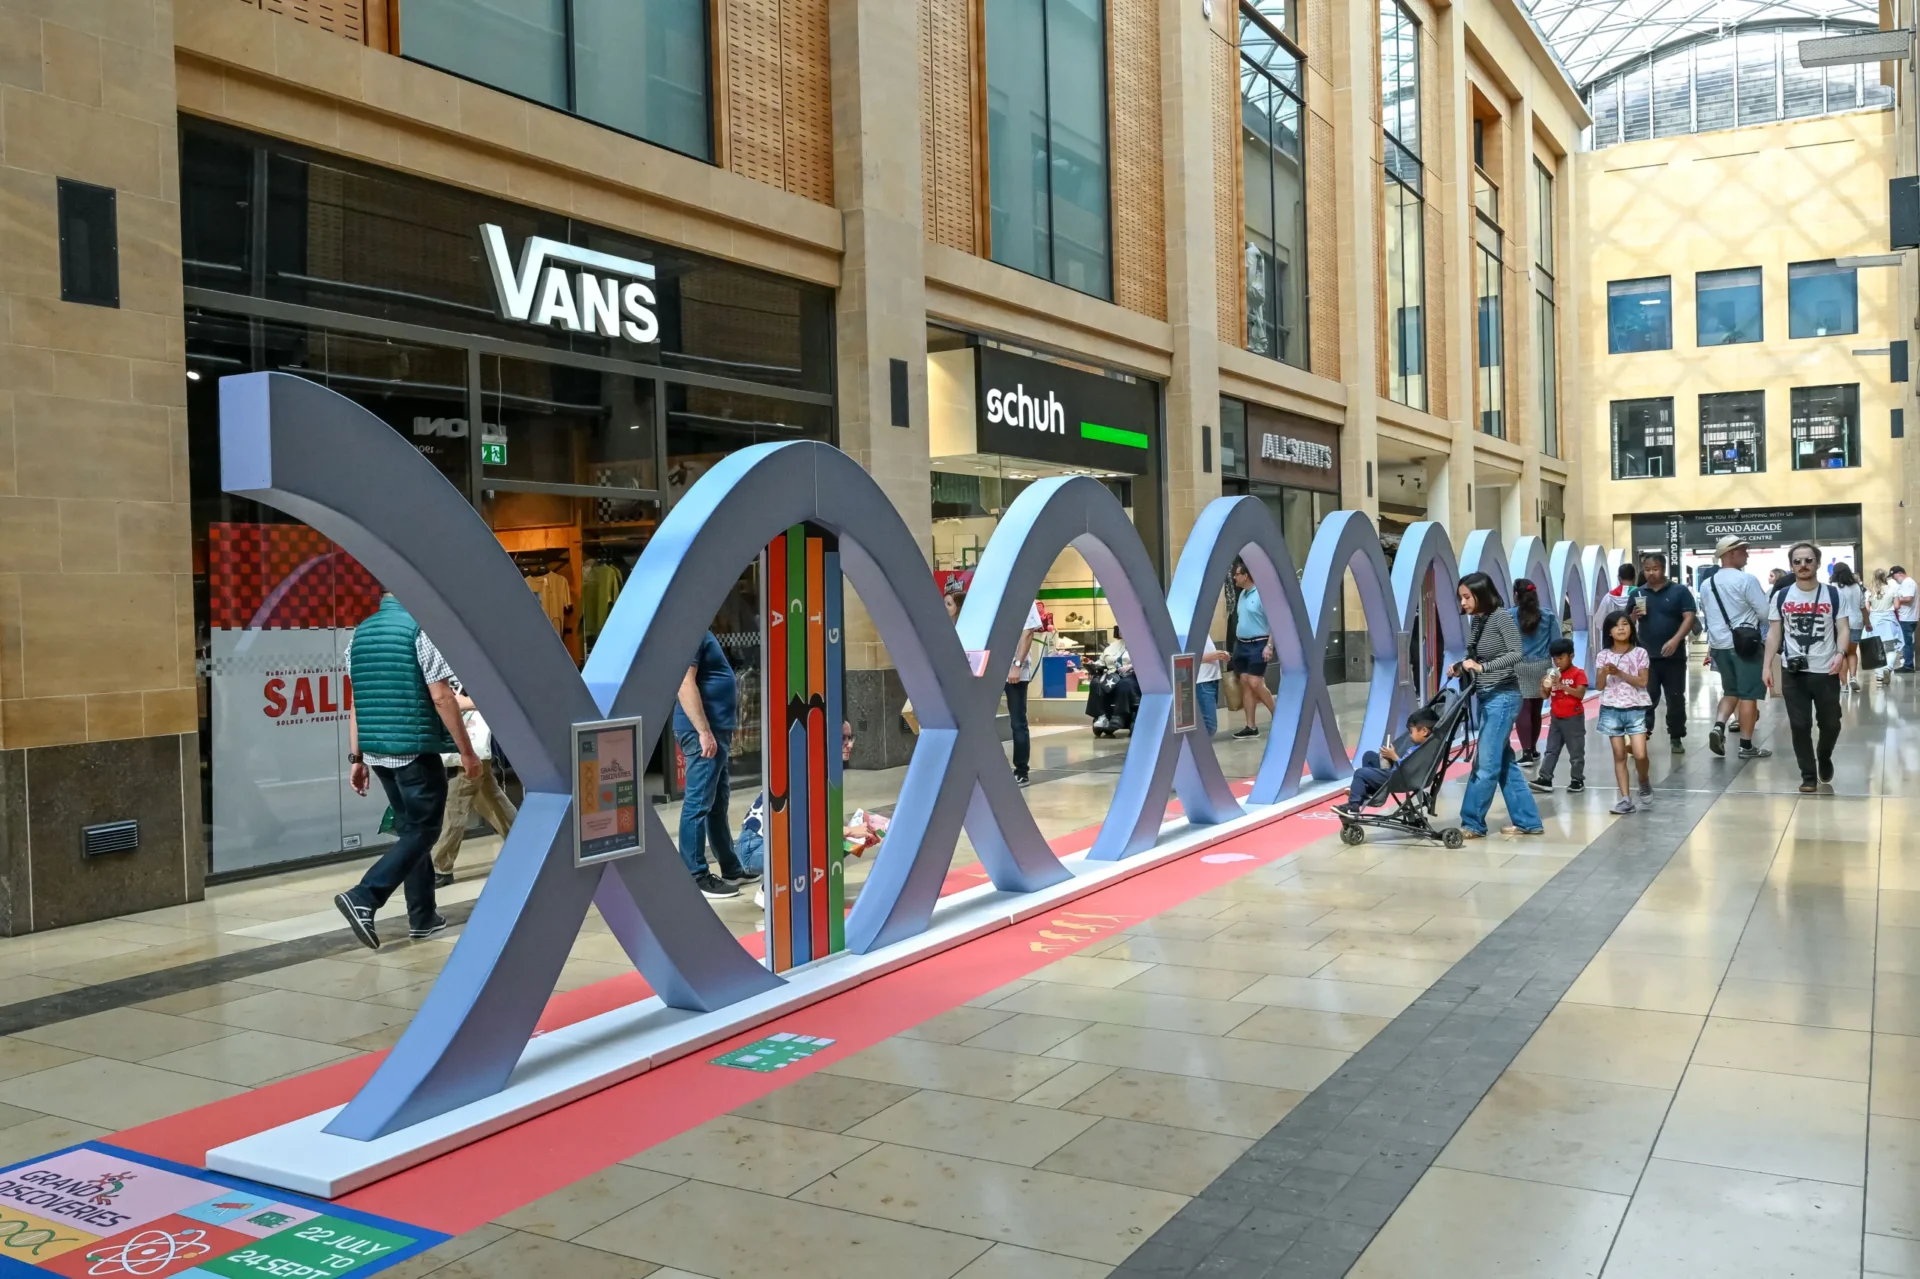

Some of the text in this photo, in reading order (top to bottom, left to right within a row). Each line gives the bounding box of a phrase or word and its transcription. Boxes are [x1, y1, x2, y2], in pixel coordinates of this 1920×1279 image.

[479, 223, 658, 343] VANS
[986, 383, 1064, 434] schuh
[1262, 433, 1332, 469] ALLSAINTS
[1706, 523, 1782, 533] GRAND ARCADE
[771, 610, 784, 628] A
[810, 612, 821, 626] T
[828, 628, 840, 644] G
[794, 876, 806, 892] G
[813, 867, 824, 883] A
[775, 884, 786, 897] T
[20, 1170, 104, 1198] GRAND
[0, 1180, 132, 1227] DISCOVERIES
[294, 1226, 391, 1256] 22 JULY
[226, 1250, 332, 1279] 24 SEPT
[320, 1254, 355, 1268] TO
